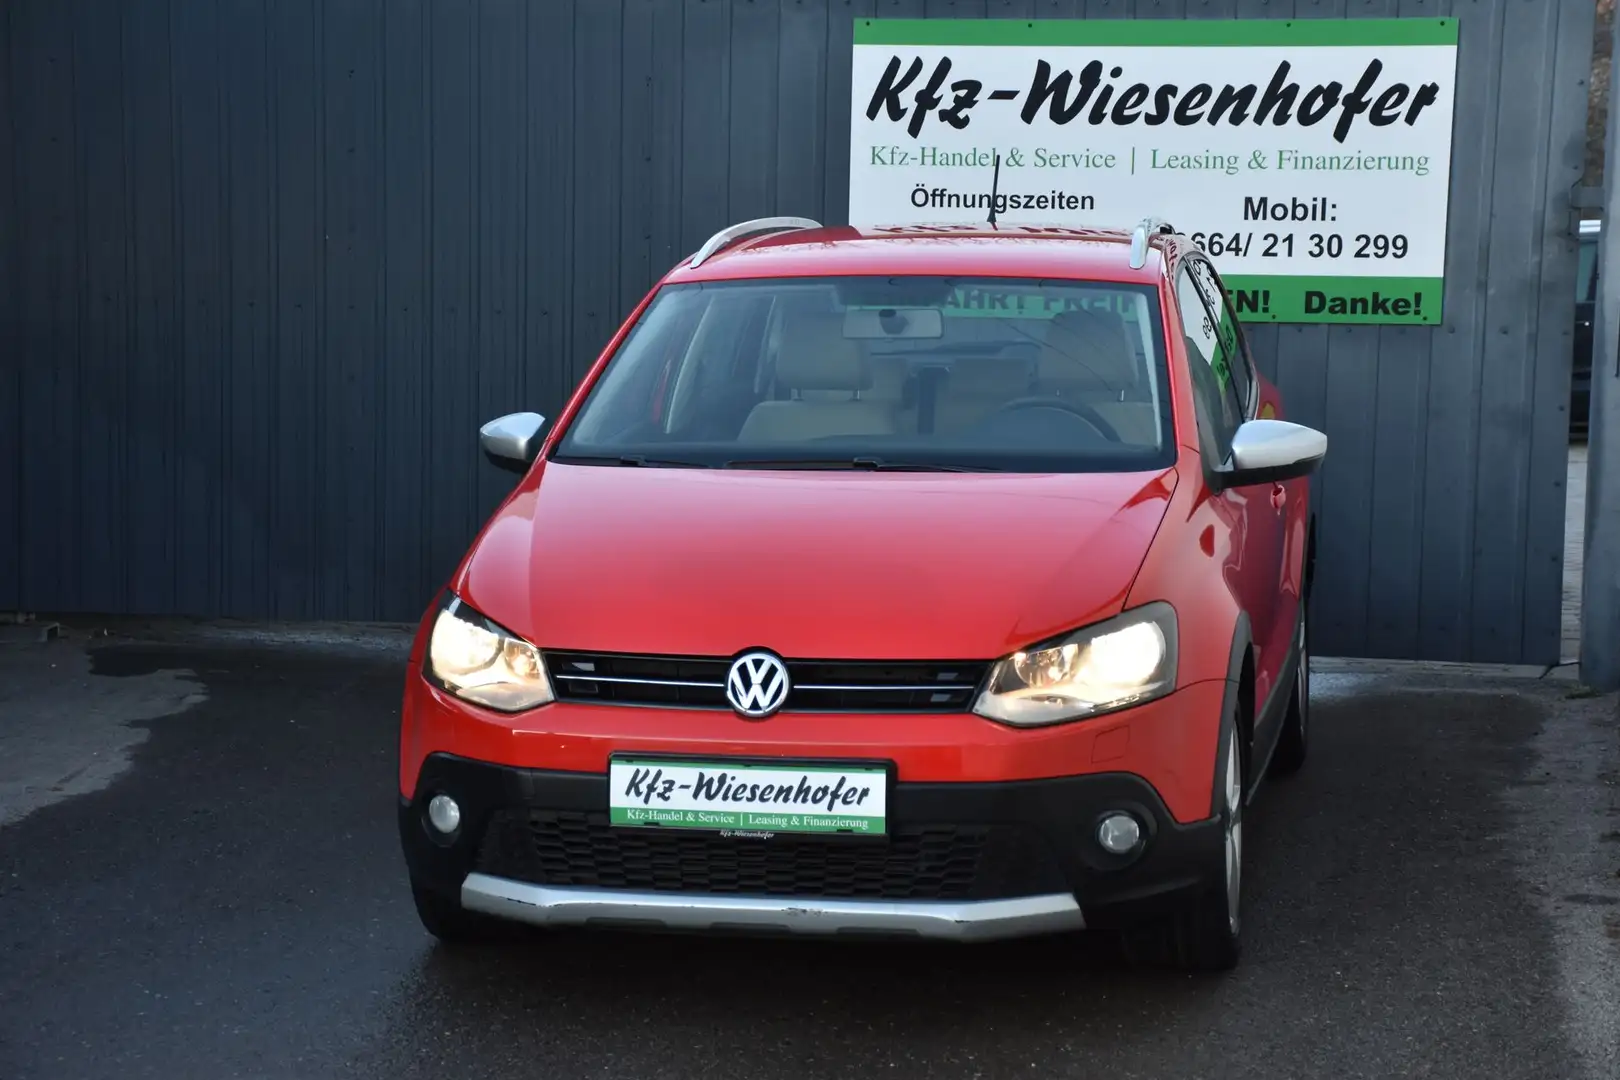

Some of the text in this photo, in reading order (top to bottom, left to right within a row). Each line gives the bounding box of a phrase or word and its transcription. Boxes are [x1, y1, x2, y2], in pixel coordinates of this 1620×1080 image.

[866, 55, 1440, 143] Kfz-Wiesenhofer
[870, 145, 997, 168] Kfz-Handel
[1005, 149, 1024, 168] &
[1033, 147, 1117, 168] Service
[1150, 149, 1239, 175] Leasing
[1247, 150, 1267, 170] &
[1277, 149, 1430, 176] Finanzierung
[911, 183, 1095, 213] Öffnungszeiten
[1243, 196, 1337, 221] Mobil:
[1176, 232, 1253, 257] 664/
[1262, 233, 1294, 257] 21
[1308, 233, 1343, 258] 30
[1354, 234, 1408, 259] 299
[1304, 291, 1422, 316] Danke!
[625, 768, 870, 812] Kfz-Wiesenhofer
[627, 809, 683, 821] Kfz-Handel
[686, 812, 696, 822] &
[698, 812, 735, 823] Service
[749, 814, 788, 827] Leasing
[790, 816, 800, 826] &
[803, 816, 868, 830] Finanzierung
